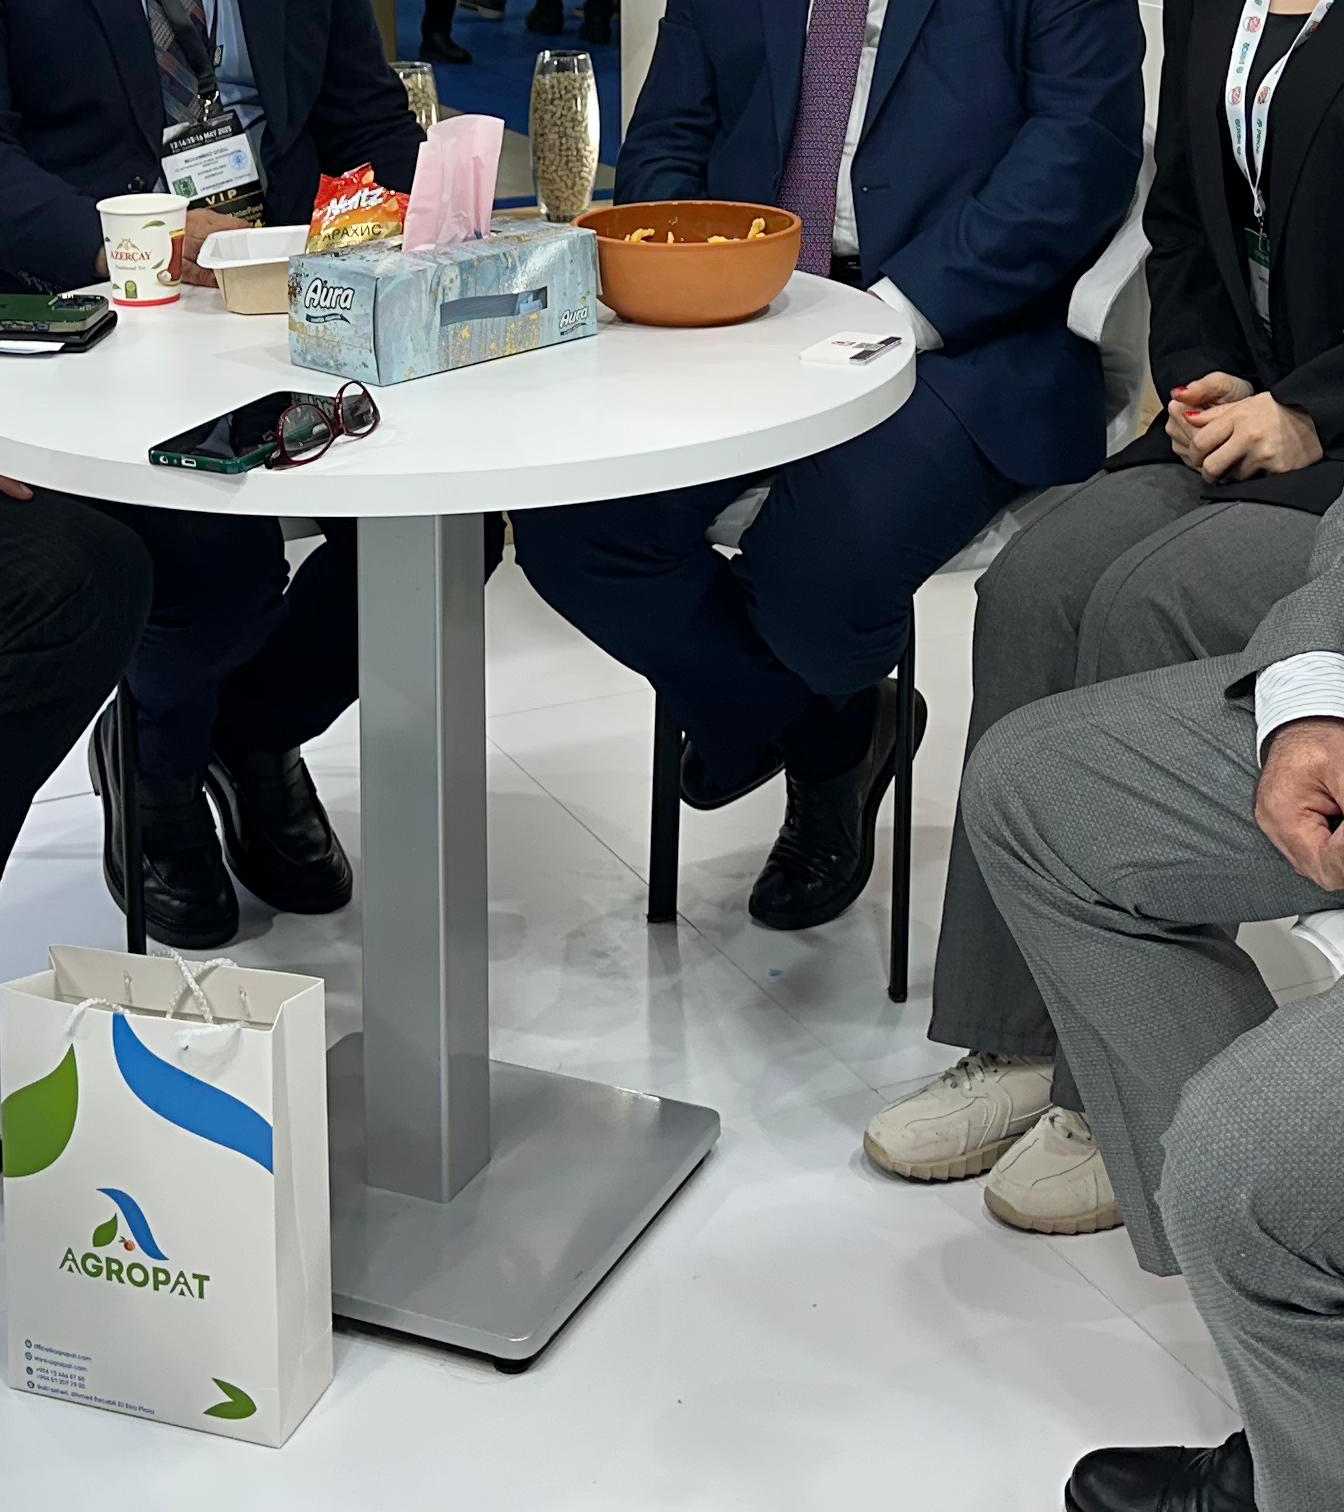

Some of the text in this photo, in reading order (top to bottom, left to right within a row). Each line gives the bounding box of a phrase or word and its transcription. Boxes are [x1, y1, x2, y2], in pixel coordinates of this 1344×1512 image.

[205, 189, 237, 206] VIP
[322, 223, 383, 242] АРАХИС
[304, 277, 356, 311] Aura
[559, 306, 588, 329] Aura
[58, 1247, 211, 1300] AGROPAT
